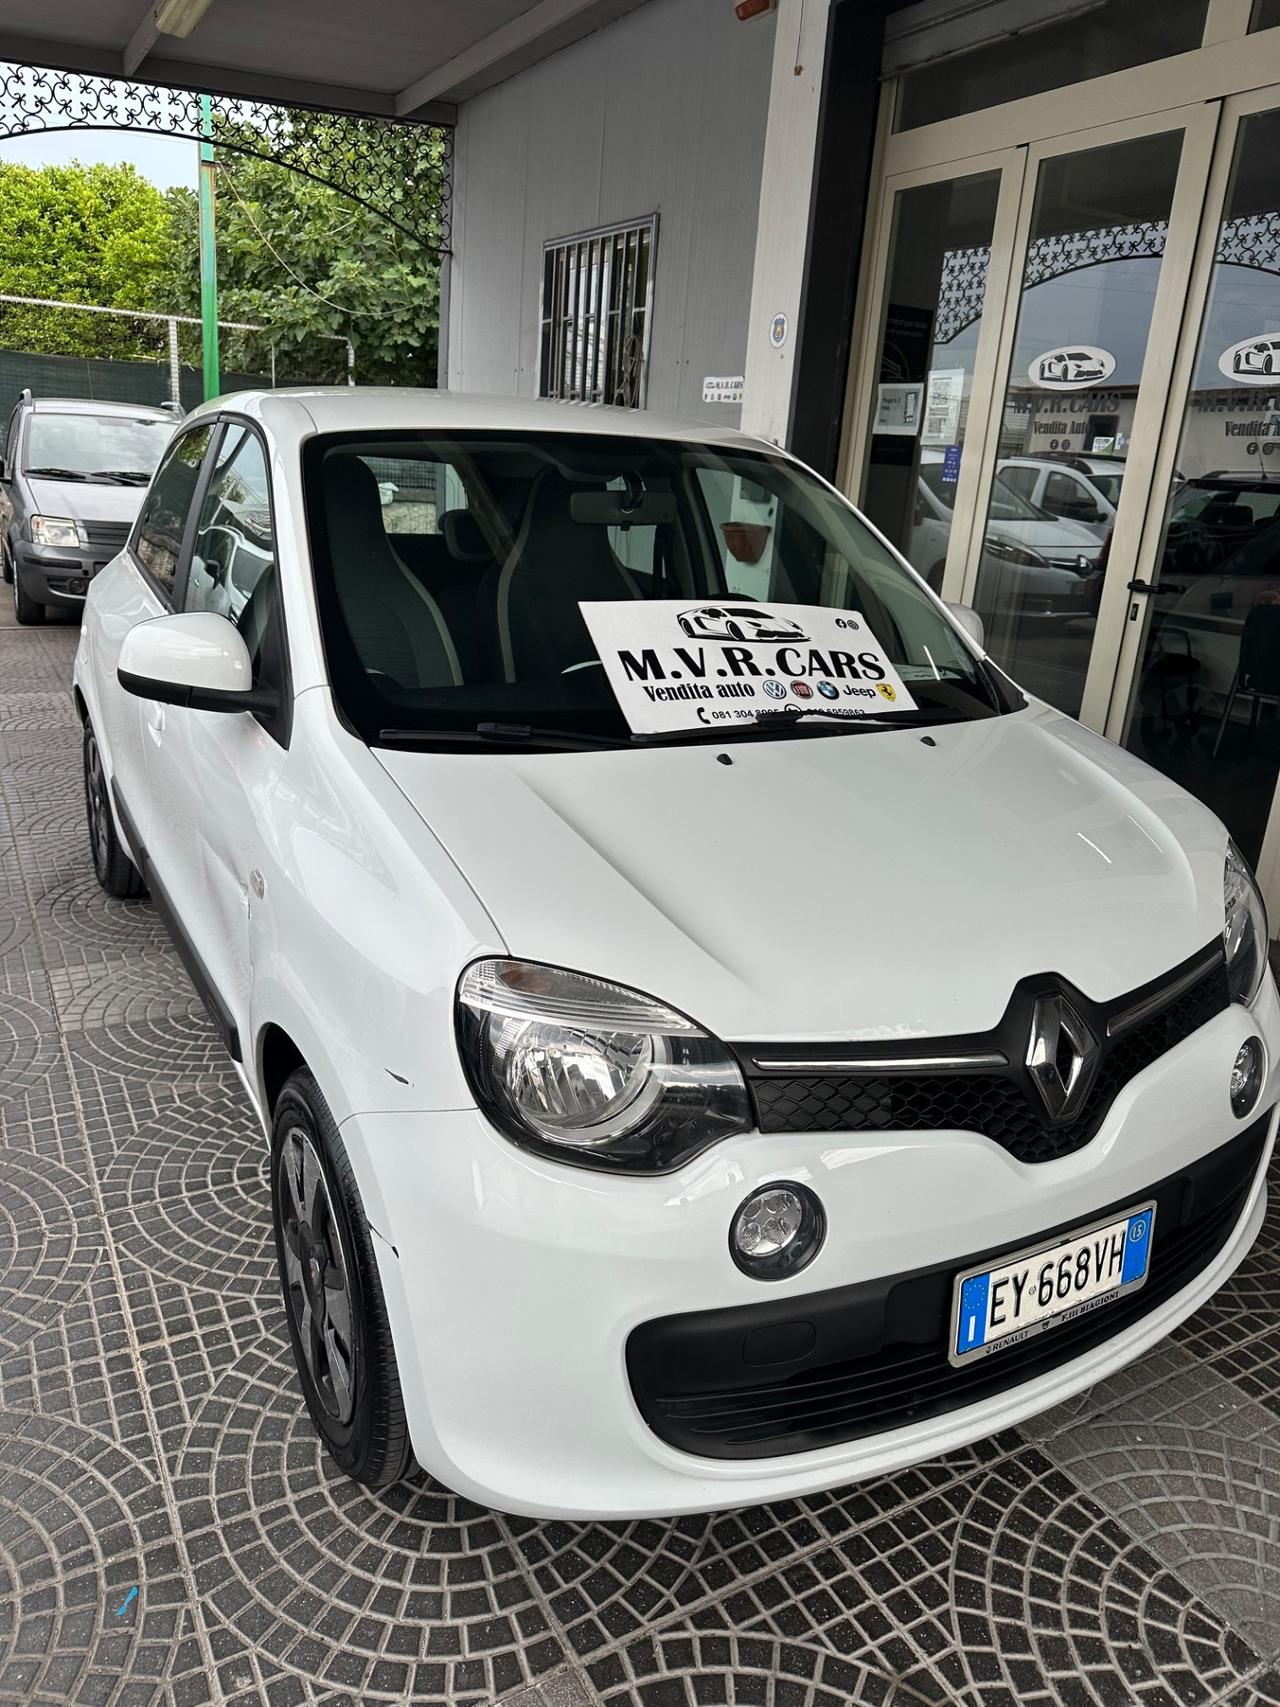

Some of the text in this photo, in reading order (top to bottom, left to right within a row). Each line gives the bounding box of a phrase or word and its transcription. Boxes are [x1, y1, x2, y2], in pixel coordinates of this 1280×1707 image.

[1033, 419, 1068, 435] Vendita
[1225, 420, 1270, 437] Vendita
[616, 647, 887, 682] M.V.R.CARS
[642, 682, 715, 702] Vendita
[716, 682, 755, 698] auto
[843, 685, 877, 699] Jeep
[711, 711, 732, 719] 081
[733, 710, 754, 719] 304
[992, 1329, 1030, 1352] RENAULT
